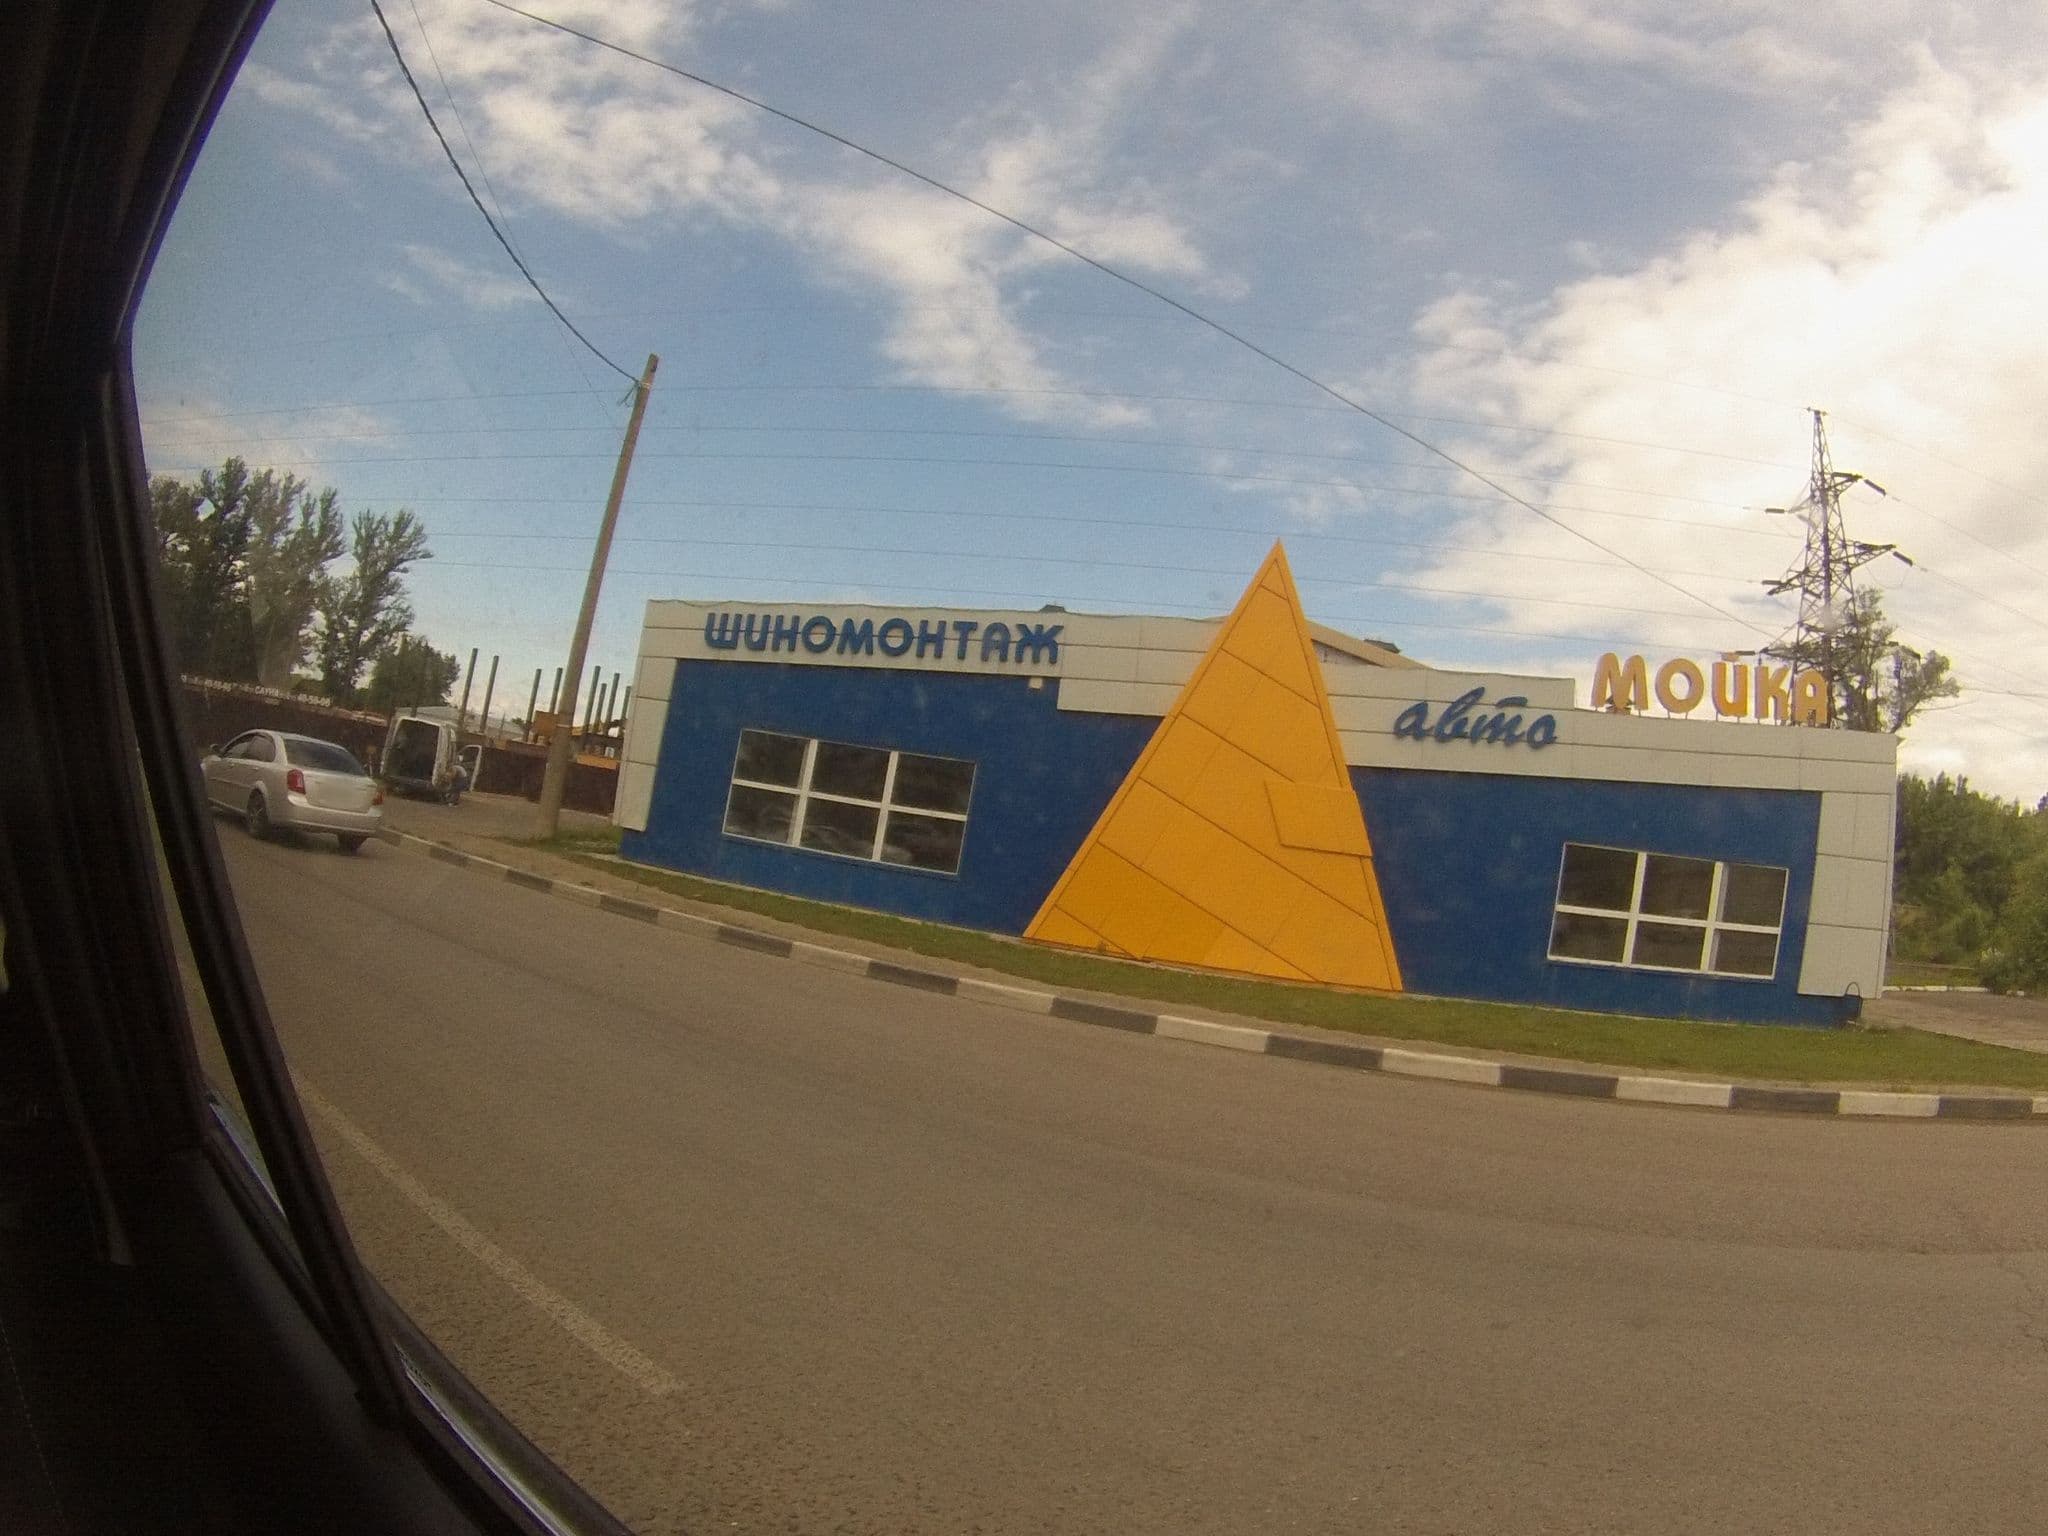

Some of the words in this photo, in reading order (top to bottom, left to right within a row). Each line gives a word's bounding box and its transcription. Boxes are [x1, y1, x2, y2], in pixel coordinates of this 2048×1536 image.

[704, 612, 1064, 665] ШИНОМОНТАЖ
[1392, 686, 1557, 750] авто
[1591, 652, 1828, 727] МОЙКА
